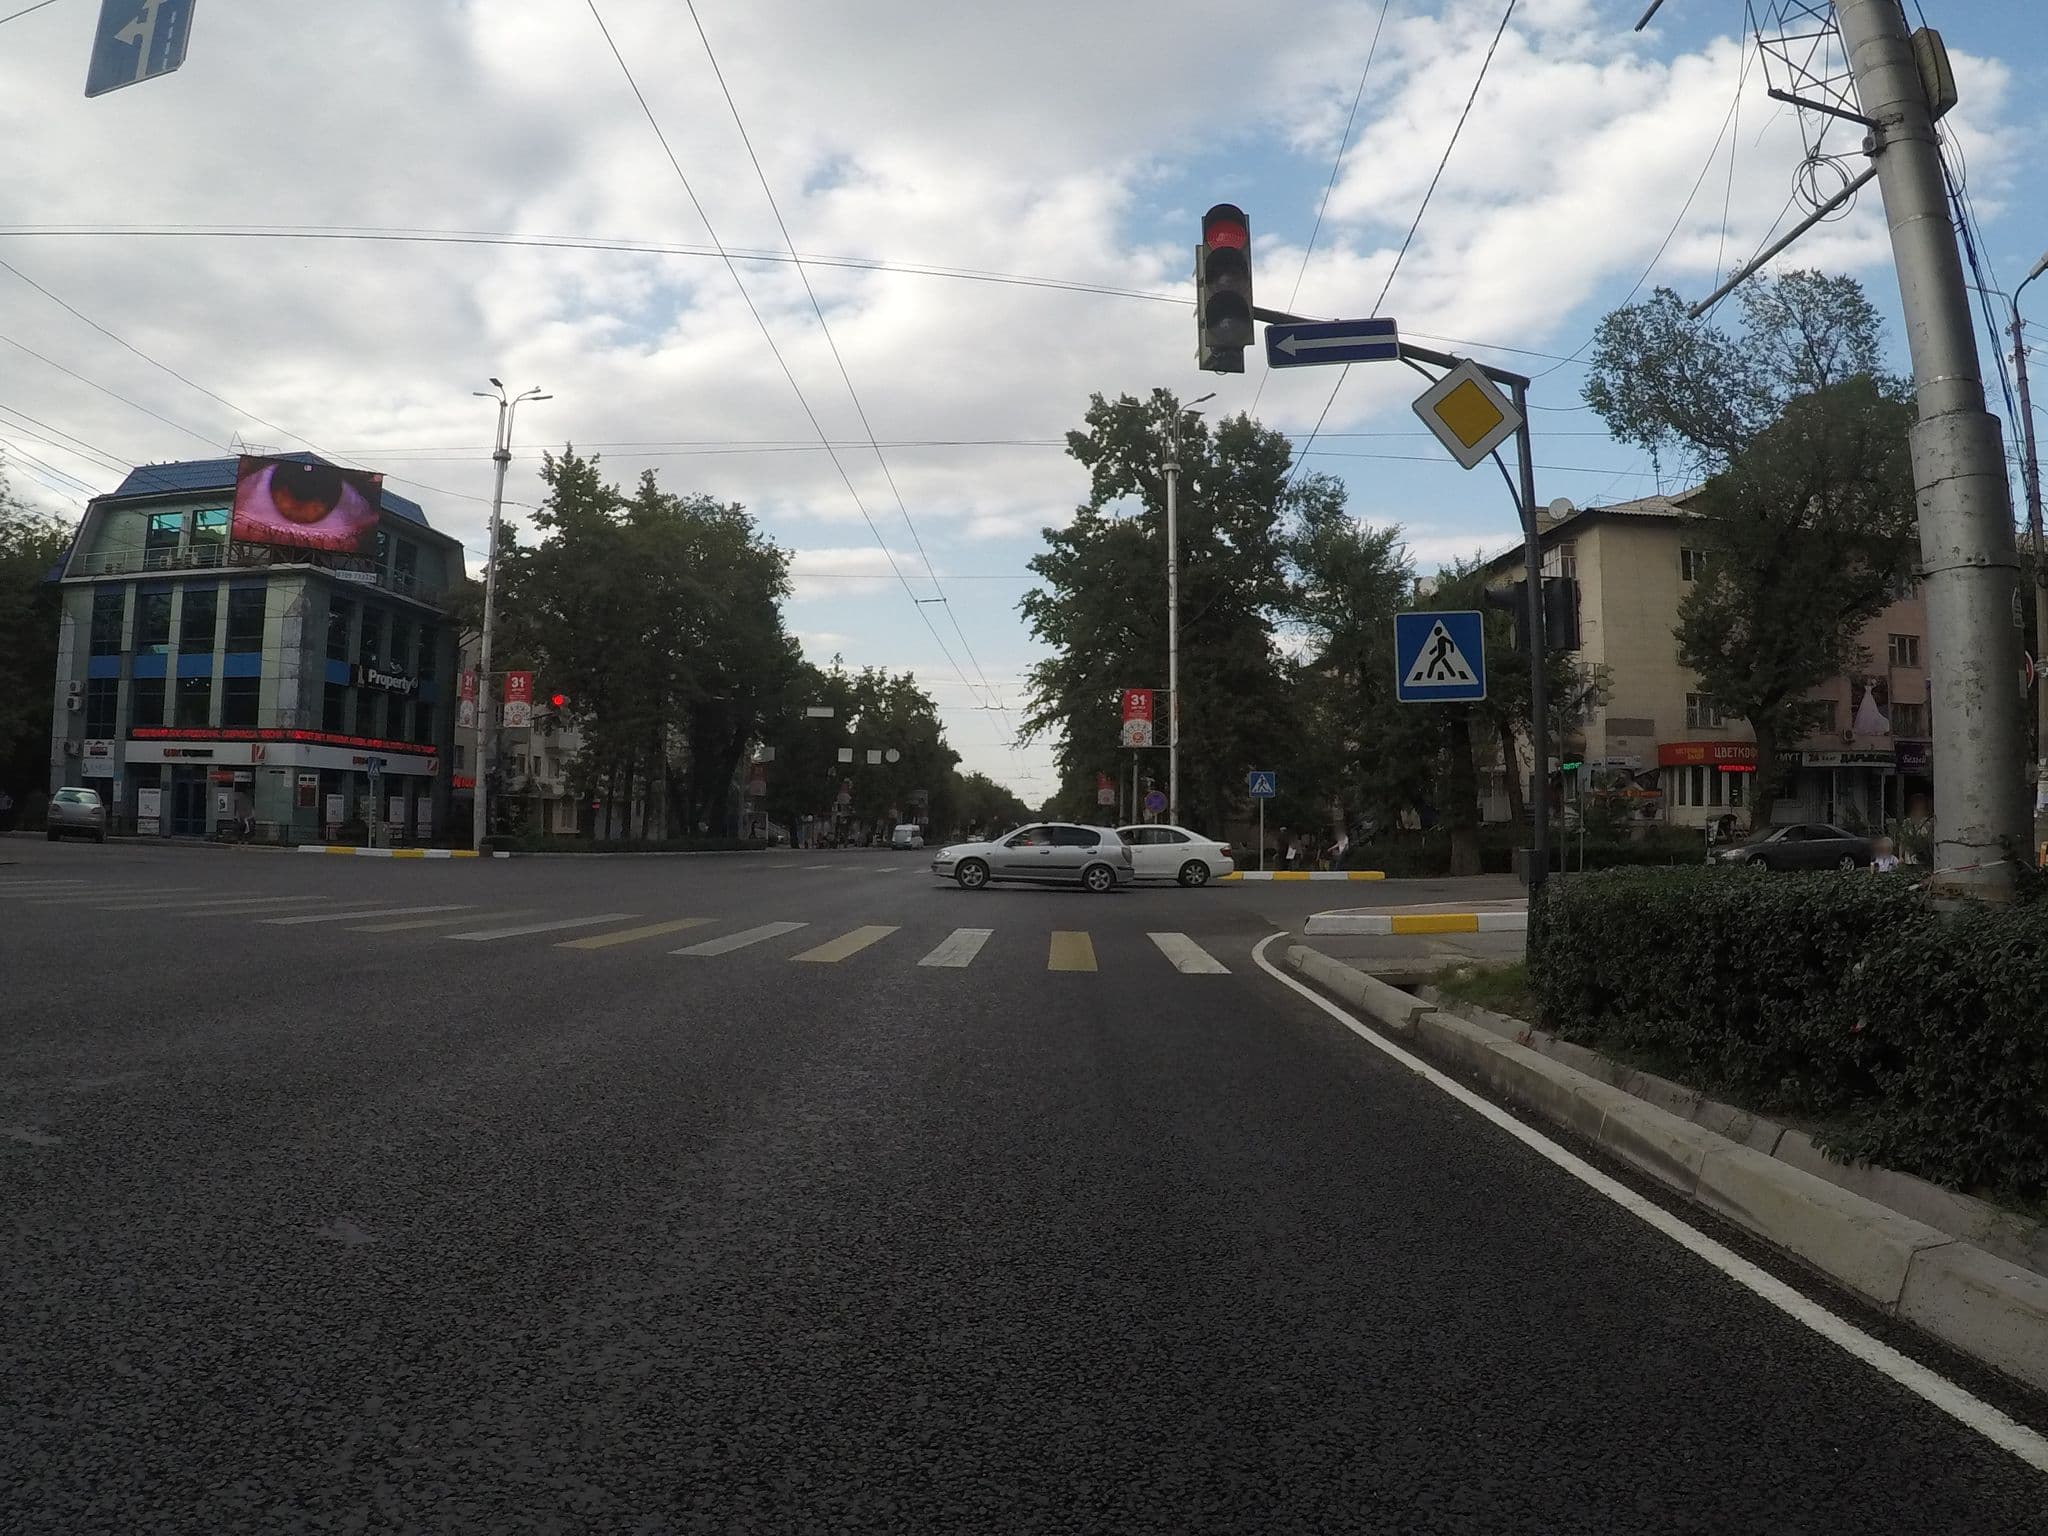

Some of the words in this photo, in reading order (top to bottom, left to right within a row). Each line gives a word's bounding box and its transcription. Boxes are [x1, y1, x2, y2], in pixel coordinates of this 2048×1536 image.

[368, 669, 413, 694] Property
[511, 676, 525, 688] 31
[1131, 694, 1146, 705] 31
